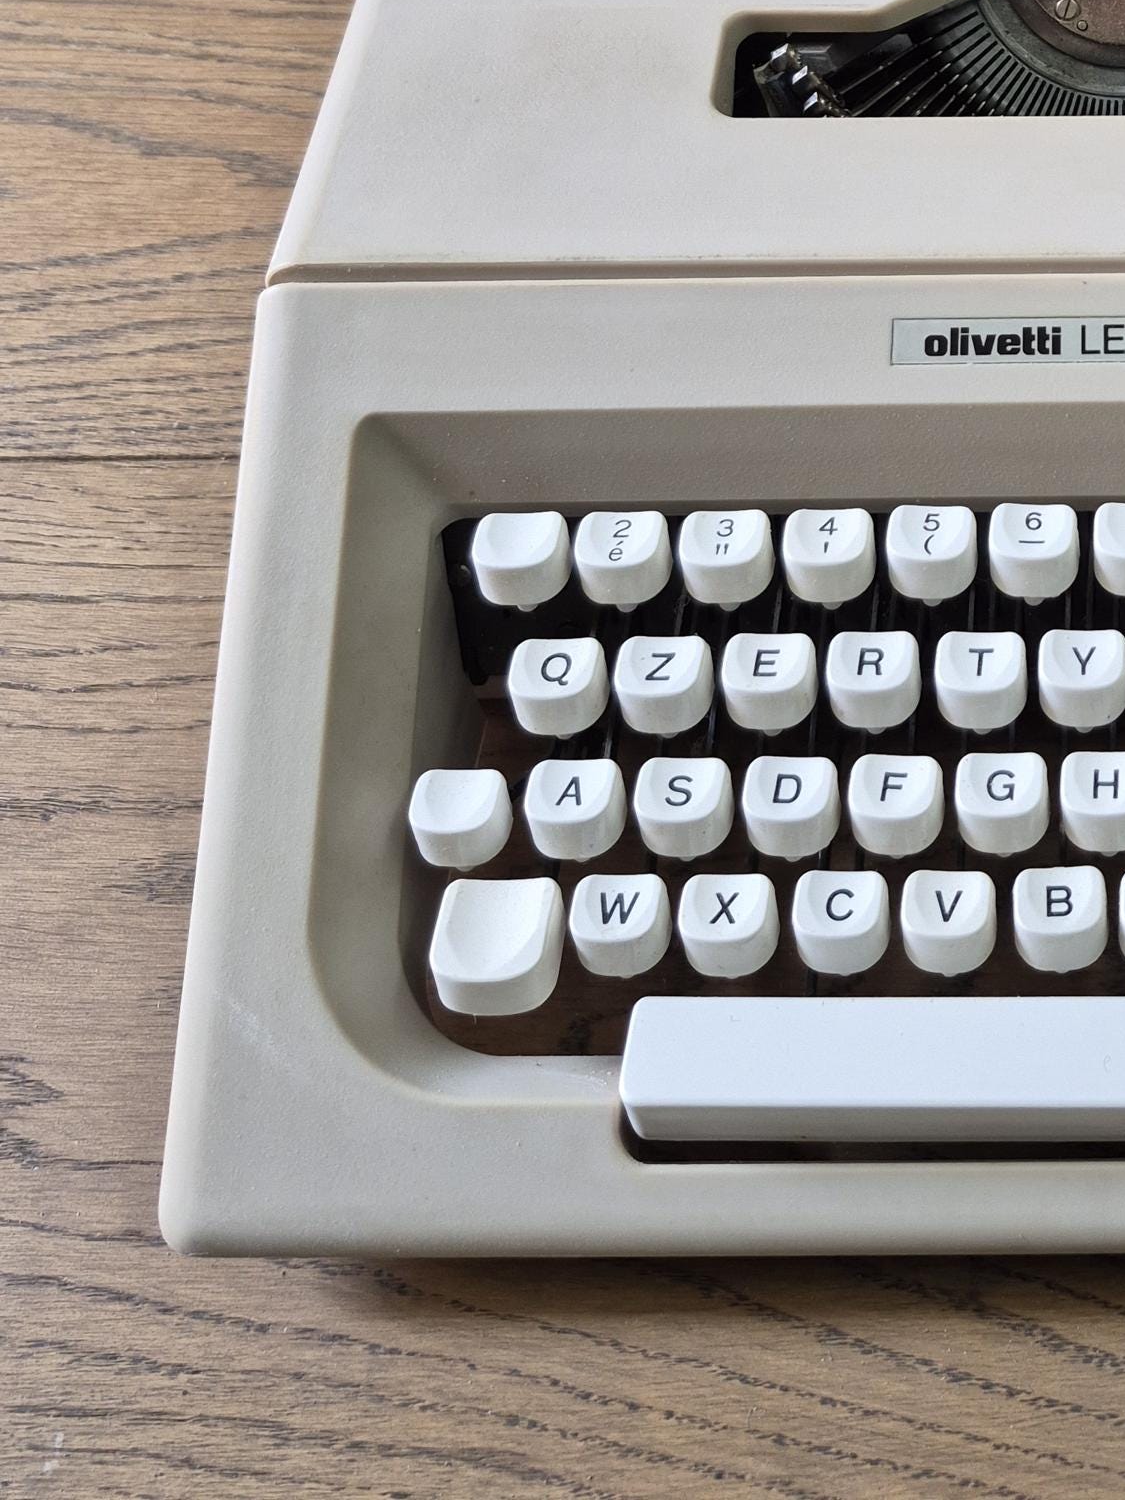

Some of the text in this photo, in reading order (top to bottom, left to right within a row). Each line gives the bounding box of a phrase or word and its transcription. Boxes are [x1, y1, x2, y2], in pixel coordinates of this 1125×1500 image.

[923, 326, 1062, 358] olivetti
[612, 519, 632, 539] 2
[716, 518, 734, 538] 3
[818, 516, 838, 536] 4
[922, 513, 940, 532] 5
[1025, 511, 1042, 531] 6
[608, 540, 624, 562] é
[923, 534, 935, 555] (
[540, 652, 572, 686] Q
[644, 652, 676, 681] Z
[752, 649, 780, 677] E
[856, 647, 884, 676] R
[968, 648, 994, 677] T
[1072, 646, 1096, 676] Y
[555, 776, 582, 806] A
[664, 775, 693, 807] S
[772, 773, 802, 804] D
[879, 771, 908, 802] F
[986, 769, 1015, 802] G
[1092, 769, 1119, 800] H
[600, 892, 640, 925] W
[709, 892, 739, 925] X
[825, 888, 854, 922] C
[935, 890, 963, 923] V
[1045, 885, 1073, 918] B
